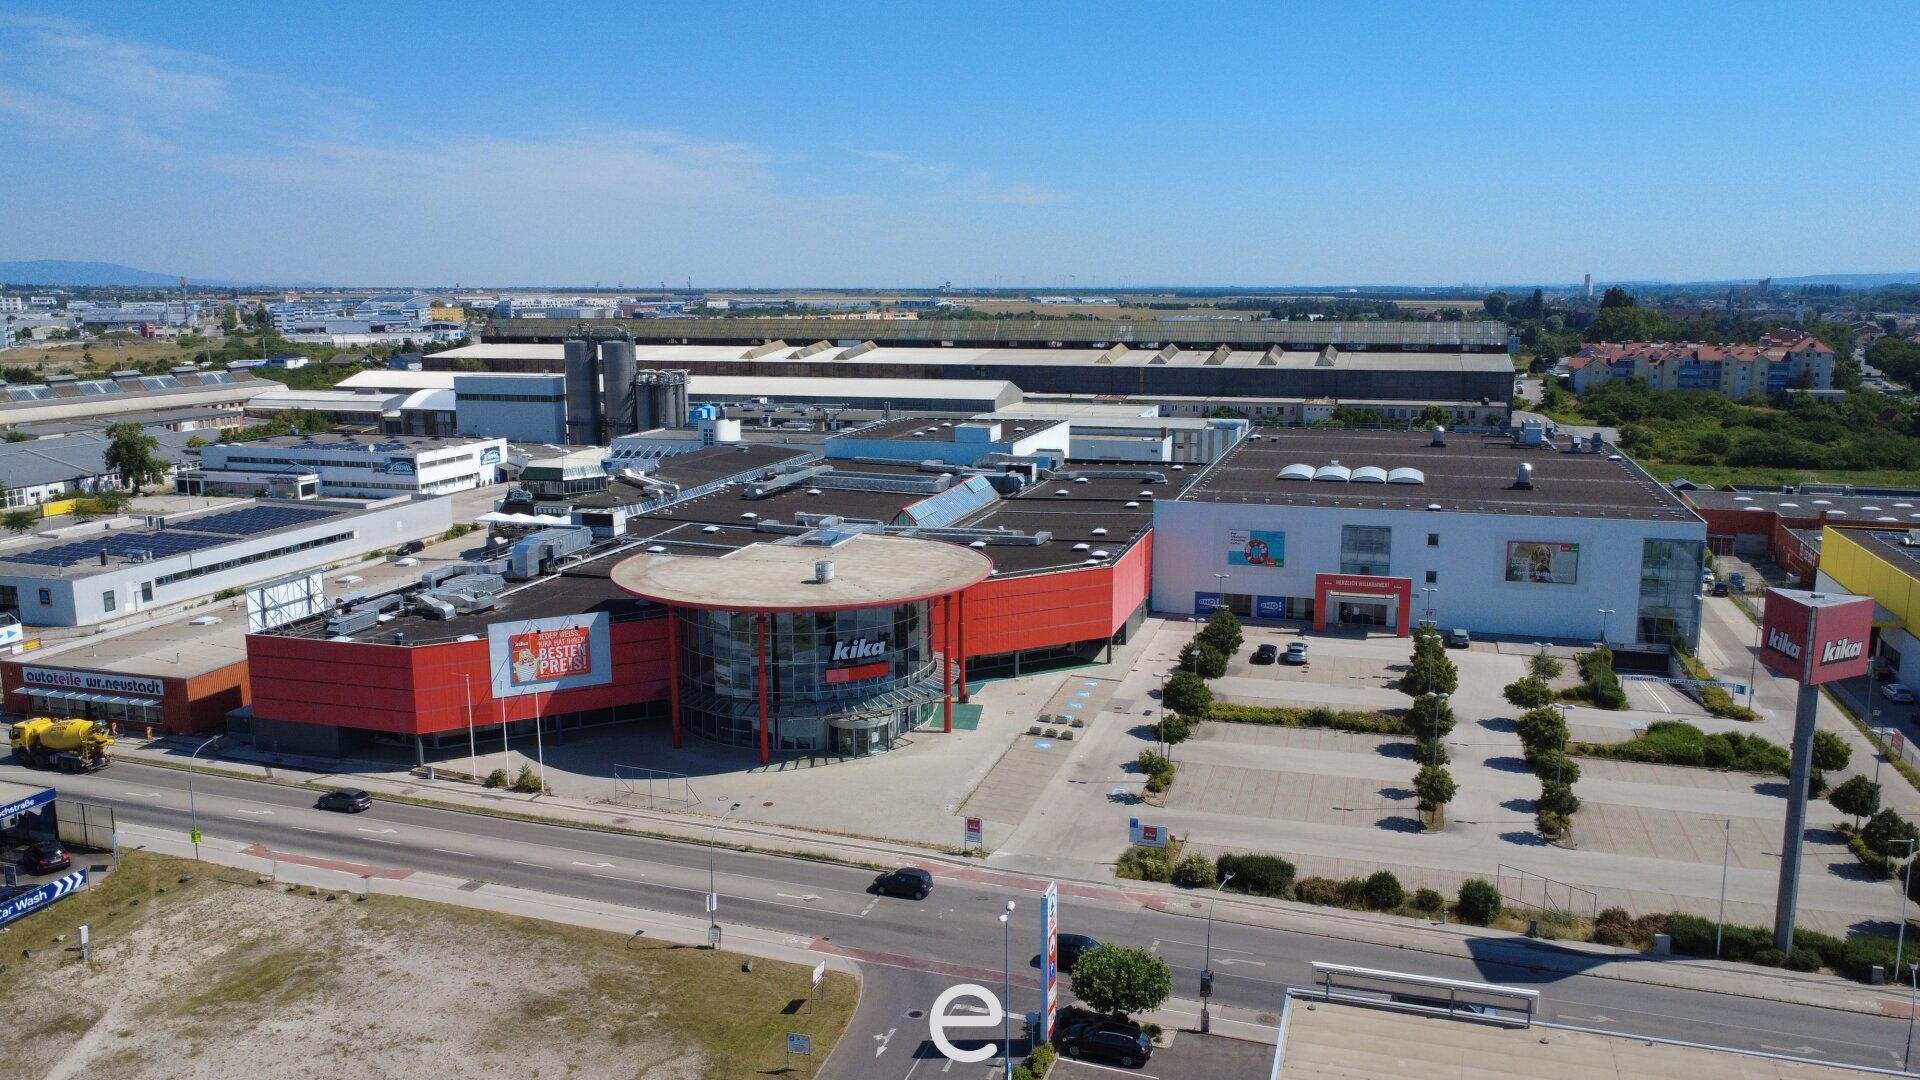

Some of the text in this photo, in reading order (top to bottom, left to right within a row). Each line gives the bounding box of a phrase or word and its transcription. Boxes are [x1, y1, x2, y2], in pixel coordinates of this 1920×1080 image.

[538, 631, 558, 641] JEDER
[538, 640, 553, 648] KIKA
[566, 636, 587, 645] IHREN
[1767, 627, 1801, 660] kika
[538, 644, 587, 661] BESTEN
[832, 638, 886, 660] kika
[1821, 638, 1863, 663] kika
[539, 655, 588, 675] PREIS!
[26, 671, 161, 694] autoteile wr.neustadt
[1663, 678, 1697, 686] PARKGARAGE
[15, 890, 48, 911] Wash
